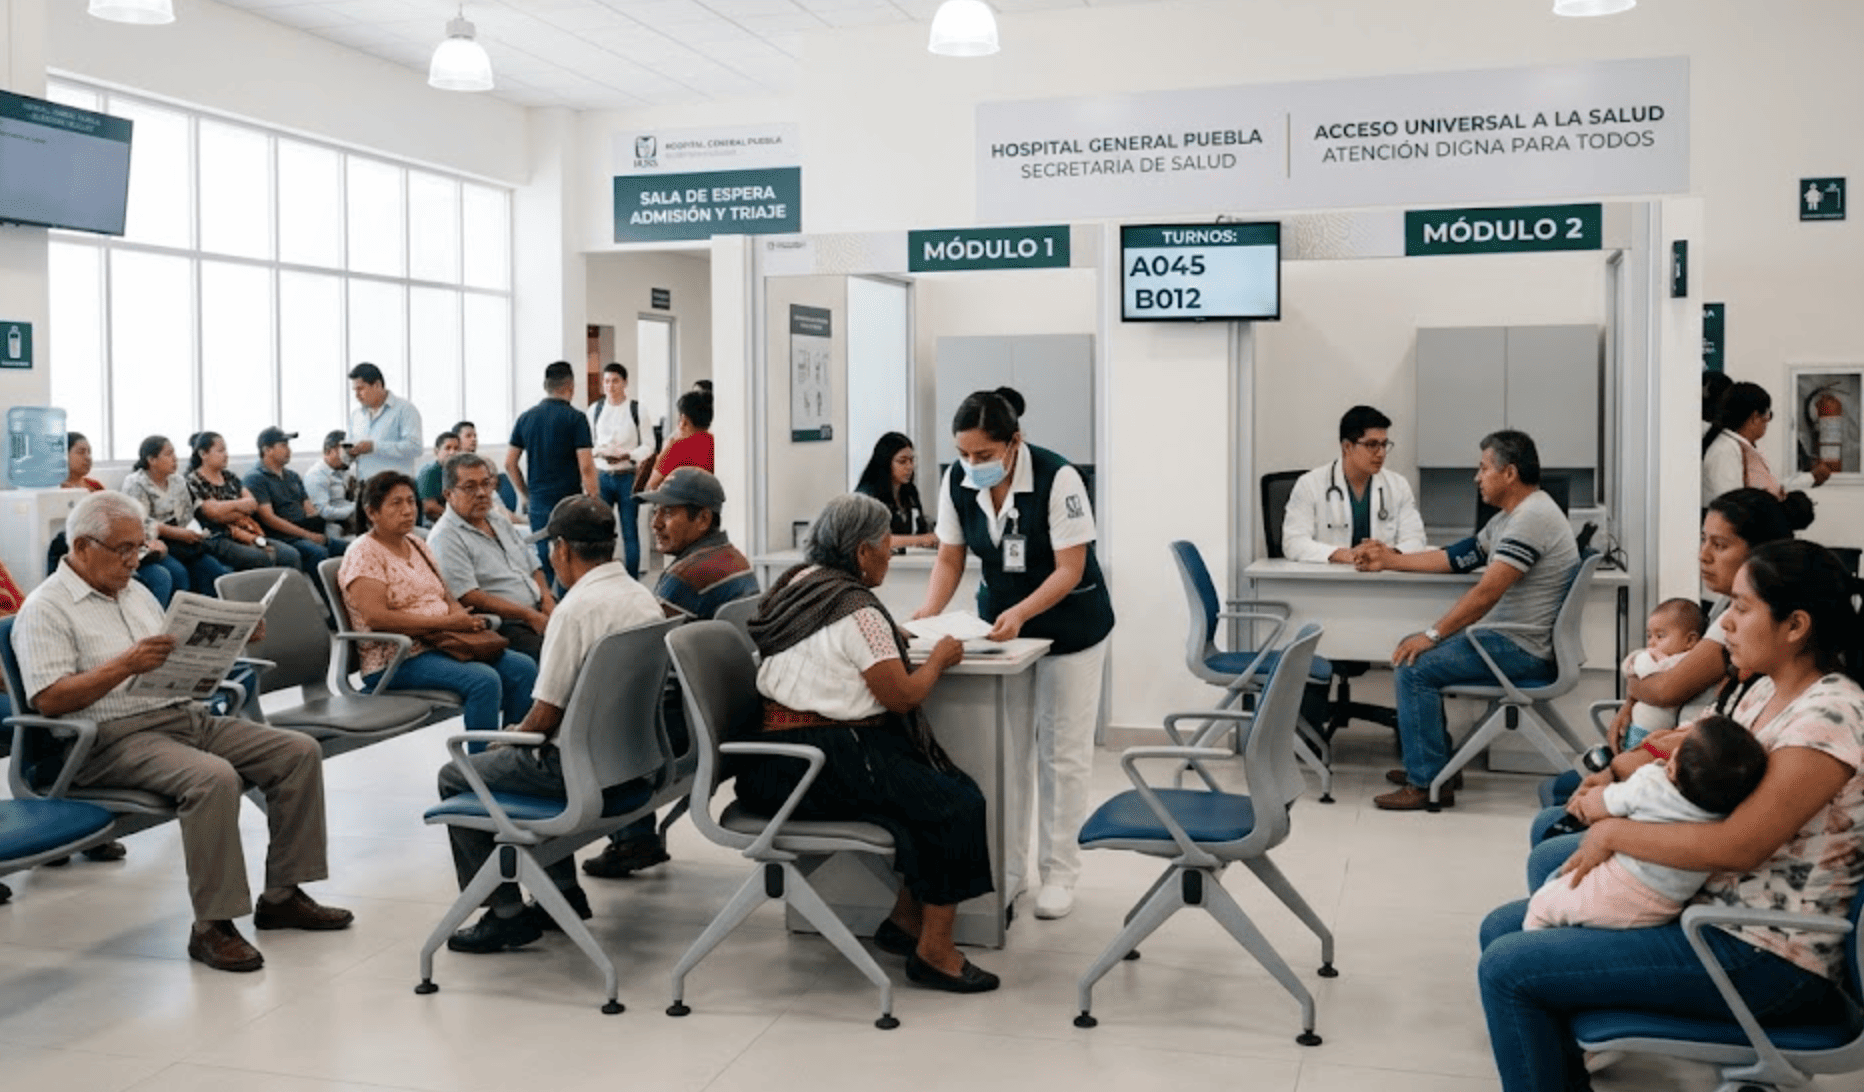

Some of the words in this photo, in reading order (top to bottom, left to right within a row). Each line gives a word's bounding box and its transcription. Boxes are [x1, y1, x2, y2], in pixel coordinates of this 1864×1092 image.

[1313, 120, 1399, 141] ACCESO
[1404, 113, 1527, 136] UNIVERSAL
[1532, 112, 1549, 128] A
[1554, 110, 1583, 127] LA
[1588, 105, 1665, 126] SALUD
[991, 139, 1084, 158] HOSPITAL
[1088, 134, 1179, 153] GENERAL
[1183, 129, 1264, 149] PUEBLA
[1322, 137, 1429, 163] ATENCIÓN
[1436, 138, 1505, 158] DIGNA
[1511, 134, 1571, 153] PARA
[1577, 129, 1655, 150] TODOS
[1140, 157, 1165, 173] DE
[1171, 154, 1237, 171] SALUD
[639, 190, 683, 206] SALA
[686, 189, 708, 204] DE
[712, 185, 777, 203] ESPERA
[629, 204, 712, 226] ADMISIÓN
[714, 207, 727, 221] Y
[729, 203, 787, 222] TRIAJE
[1161, 229, 1238, 244] TURNOS:
[1423, 216, 1557, 244] MÓDULO
[1565, 217, 1583, 239] 2
[923, 236, 1038, 261] MÓDULO
[1043, 237, 1054, 257] 1
[1129, 254, 1206, 277] A045
[1134, 287, 1202, 310] B012
